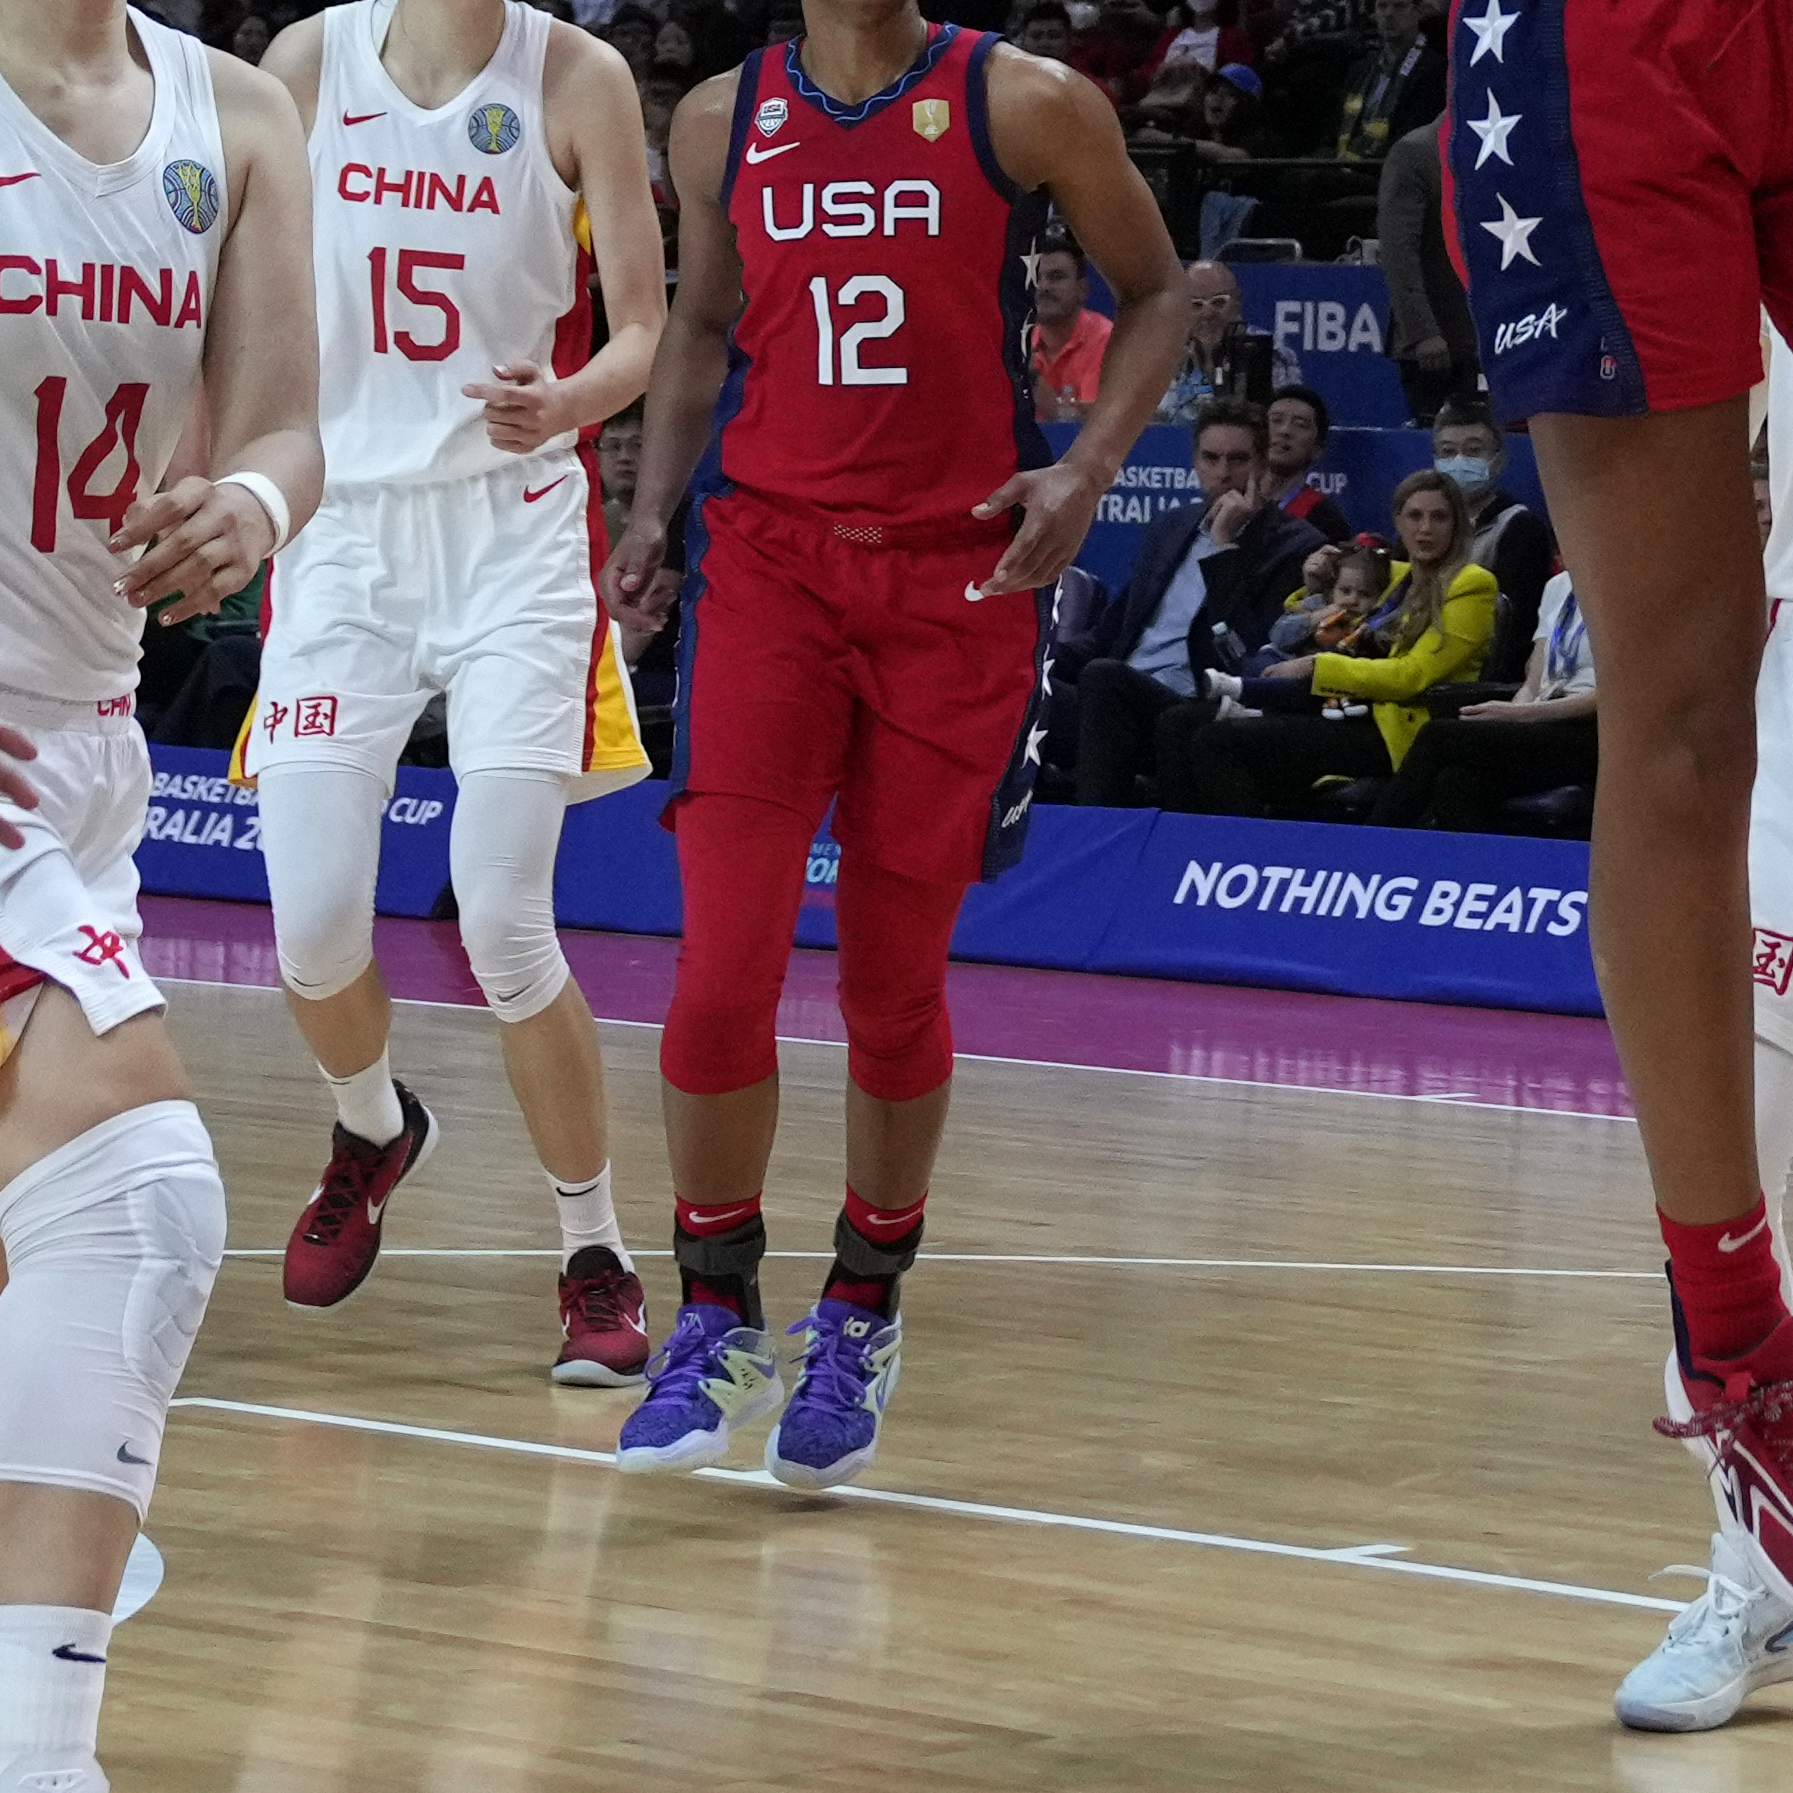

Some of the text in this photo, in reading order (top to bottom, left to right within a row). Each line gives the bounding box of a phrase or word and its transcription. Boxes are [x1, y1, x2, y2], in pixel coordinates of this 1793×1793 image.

[337, 162, 501, 216] CHINA
[762, 179, 941, 242] USA
[366, 246, 466, 362] 15
[808, 274, 908, 386] 12
[1273, 300, 1384, 354] FIBA
[1494, 302, 1568, 356] USA
[30, 375, 151, 554] 14
[262, 694, 338, 745] 中国
[387, 796, 445, 826] CUP
[1172, 859, 1590, 938] NOTHING BEATS
